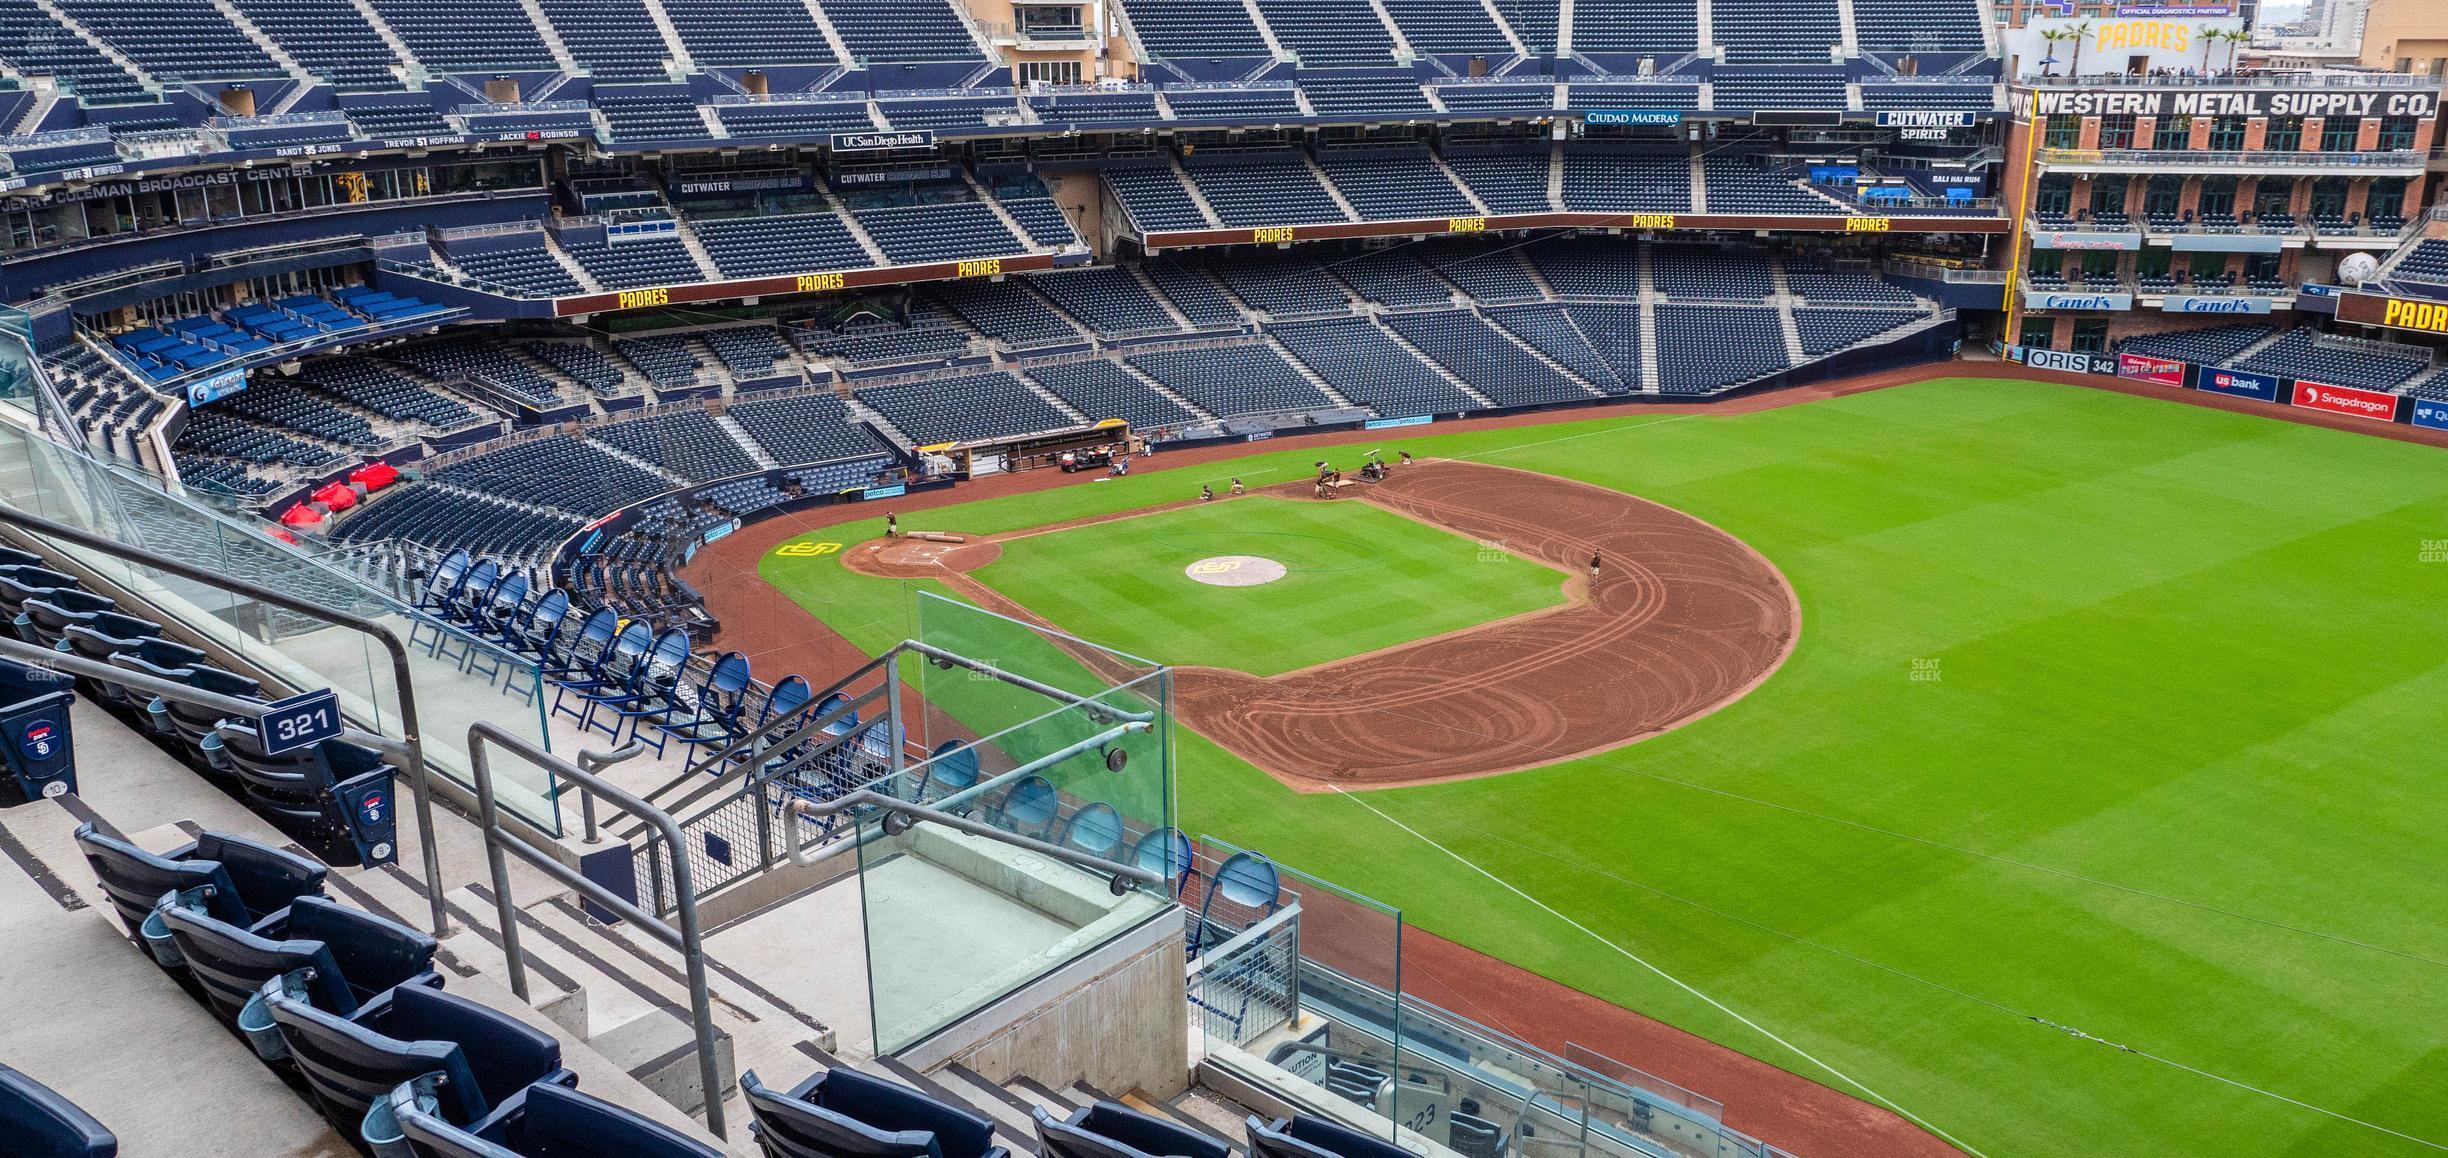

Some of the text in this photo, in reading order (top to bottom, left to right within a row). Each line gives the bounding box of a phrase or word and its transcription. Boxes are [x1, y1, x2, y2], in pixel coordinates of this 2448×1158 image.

[2152, 7, 2196, 15] DIAGNOSTICS
[2197, 7, 2227, 15] PARTNER
[2097, 20, 2189, 53] PADRES
[2038, 93, 2434, 116] WESTERN METAL SUPPLY CO.
[1586, 112, 1679, 125] CIUDAD MADERAS
[1887, 112, 1964, 125] CUTWATER
[499, 130, 579, 141] JACKIE 42 ROBINSON
[843, 134, 924, 148] UC San Diego Health
[1901, 129, 1947, 139] SPIRITS
[384, 136, 465, 148] TREVOR 51 HOFFMAN
[276, 144, 341, 157] RANDY 35 JONES
[56, 183, 133, 204] COLEMAN
[139, 172, 239, 193] BROADCAST
[247, 165, 313, 181] CENTER
[841, 173, 885, 184] CUTWATER
[681, 181, 730, 192] CUTWATER
[1449, 217, 1485, 232] PADRES
[1633, 214, 1674, 229] PADRES
[1847, 217, 1889, 231] PADRES
[1254, 227, 1293, 243] PADRES
[958, 260, 1000, 276] PADRES
[797, 274, 844, 291] PADRES
[619, 288, 668, 308] PADRES
[2047, 295, 2112, 309] Canel's
[2183, 297, 2251, 313] Canel's
[2384, 299, 2448, 333] PADR
[2031, 351, 2086, 372] ORIS
[2093, 360, 2114, 374] 342
[2231, 378, 2260, 390] bank
[2321, 392, 2389, 412] Snapdragon
[865, 489, 884, 498] petco
[277, 708, 329, 741] 321
[28, 726, 51, 739] petco
[33, 731, 48, 741] park
[50, 784, 61, 794] 10
[1288, 1051, 1317, 1073] AUTION
